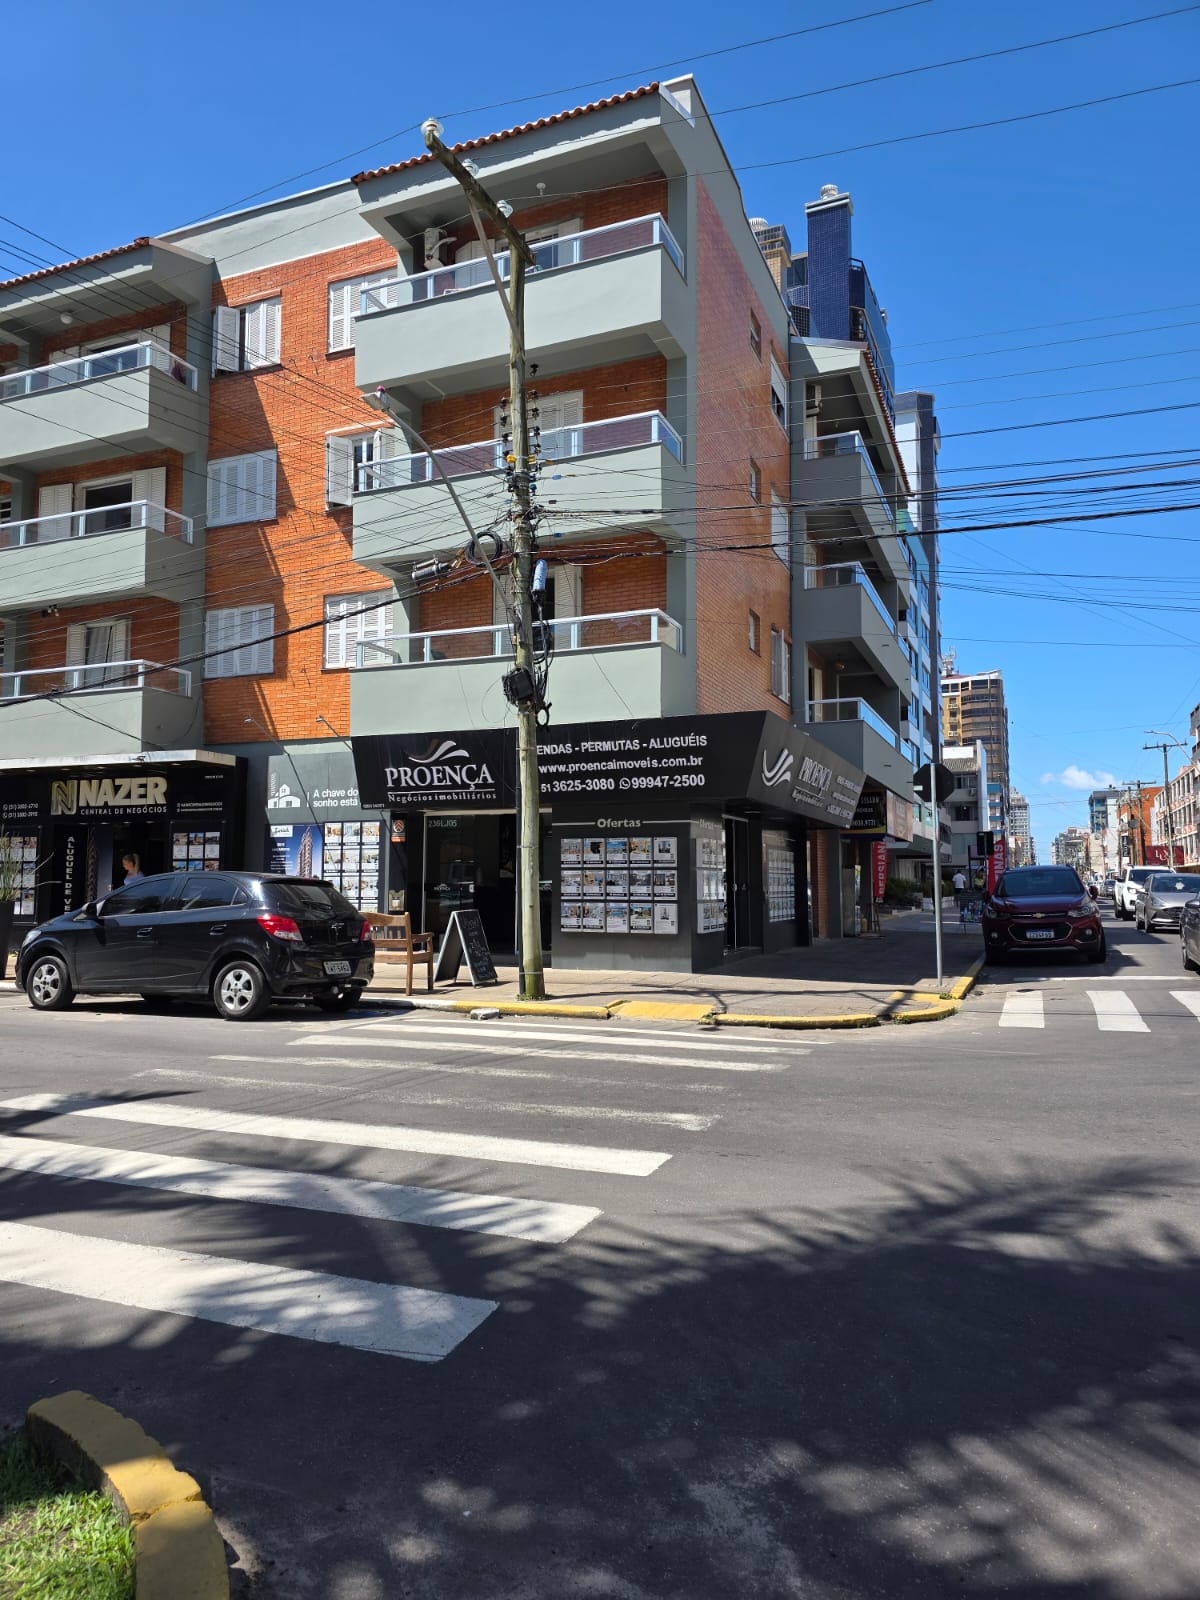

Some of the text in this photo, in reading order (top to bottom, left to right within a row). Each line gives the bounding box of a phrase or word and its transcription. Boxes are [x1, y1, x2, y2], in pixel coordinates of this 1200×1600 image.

[536, 743, 573, 755] ENDAS
[581, 740, 640, 752] PERMUTAS
[649, 733, 708, 749] ALUGUÉIS
[538, 756, 703, 774] www.proencaimoveis.com.br
[384, 763, 495, 791] PROENÇA
[541, 774, 706, 792] 51 3625-3080 99947-2500
[78, 777, 168, 807] NAZER
[313, 787, 359, 798] A chave do
[387, 792, 497, 804] Negócios imobiliários
[313, 798, 338, 807] sonho
[340, 797, 358, 807] está
[80, 807, 112, 815] CENTRAL
[126, 806, 167, 814] NEGÓCIOS
[596, 818, 641, 828] Ofertas
[65, 836, 75, 880] ALUGUEL
[64, 883, 72, 895] DE
